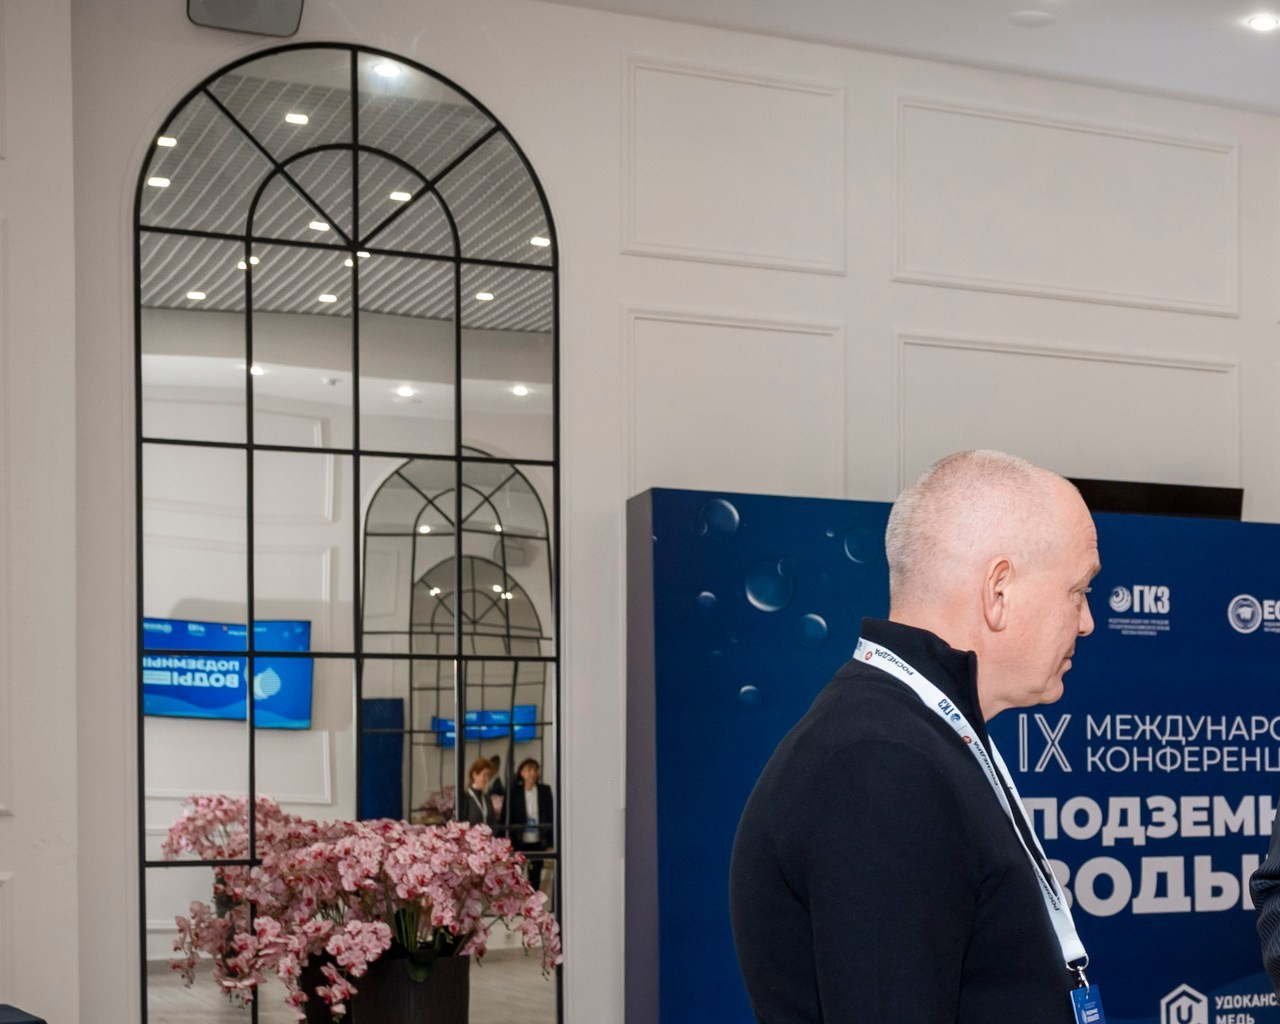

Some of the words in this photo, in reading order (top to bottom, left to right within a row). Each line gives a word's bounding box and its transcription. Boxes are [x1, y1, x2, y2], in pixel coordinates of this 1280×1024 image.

[1133, 585, 1170, 614] ГКЗ
[875, 648, 914, 676] РОСНЕДРА
[938, 698, 954, 716] ГКЗ
[1018, 714, 1072, 772] IX
